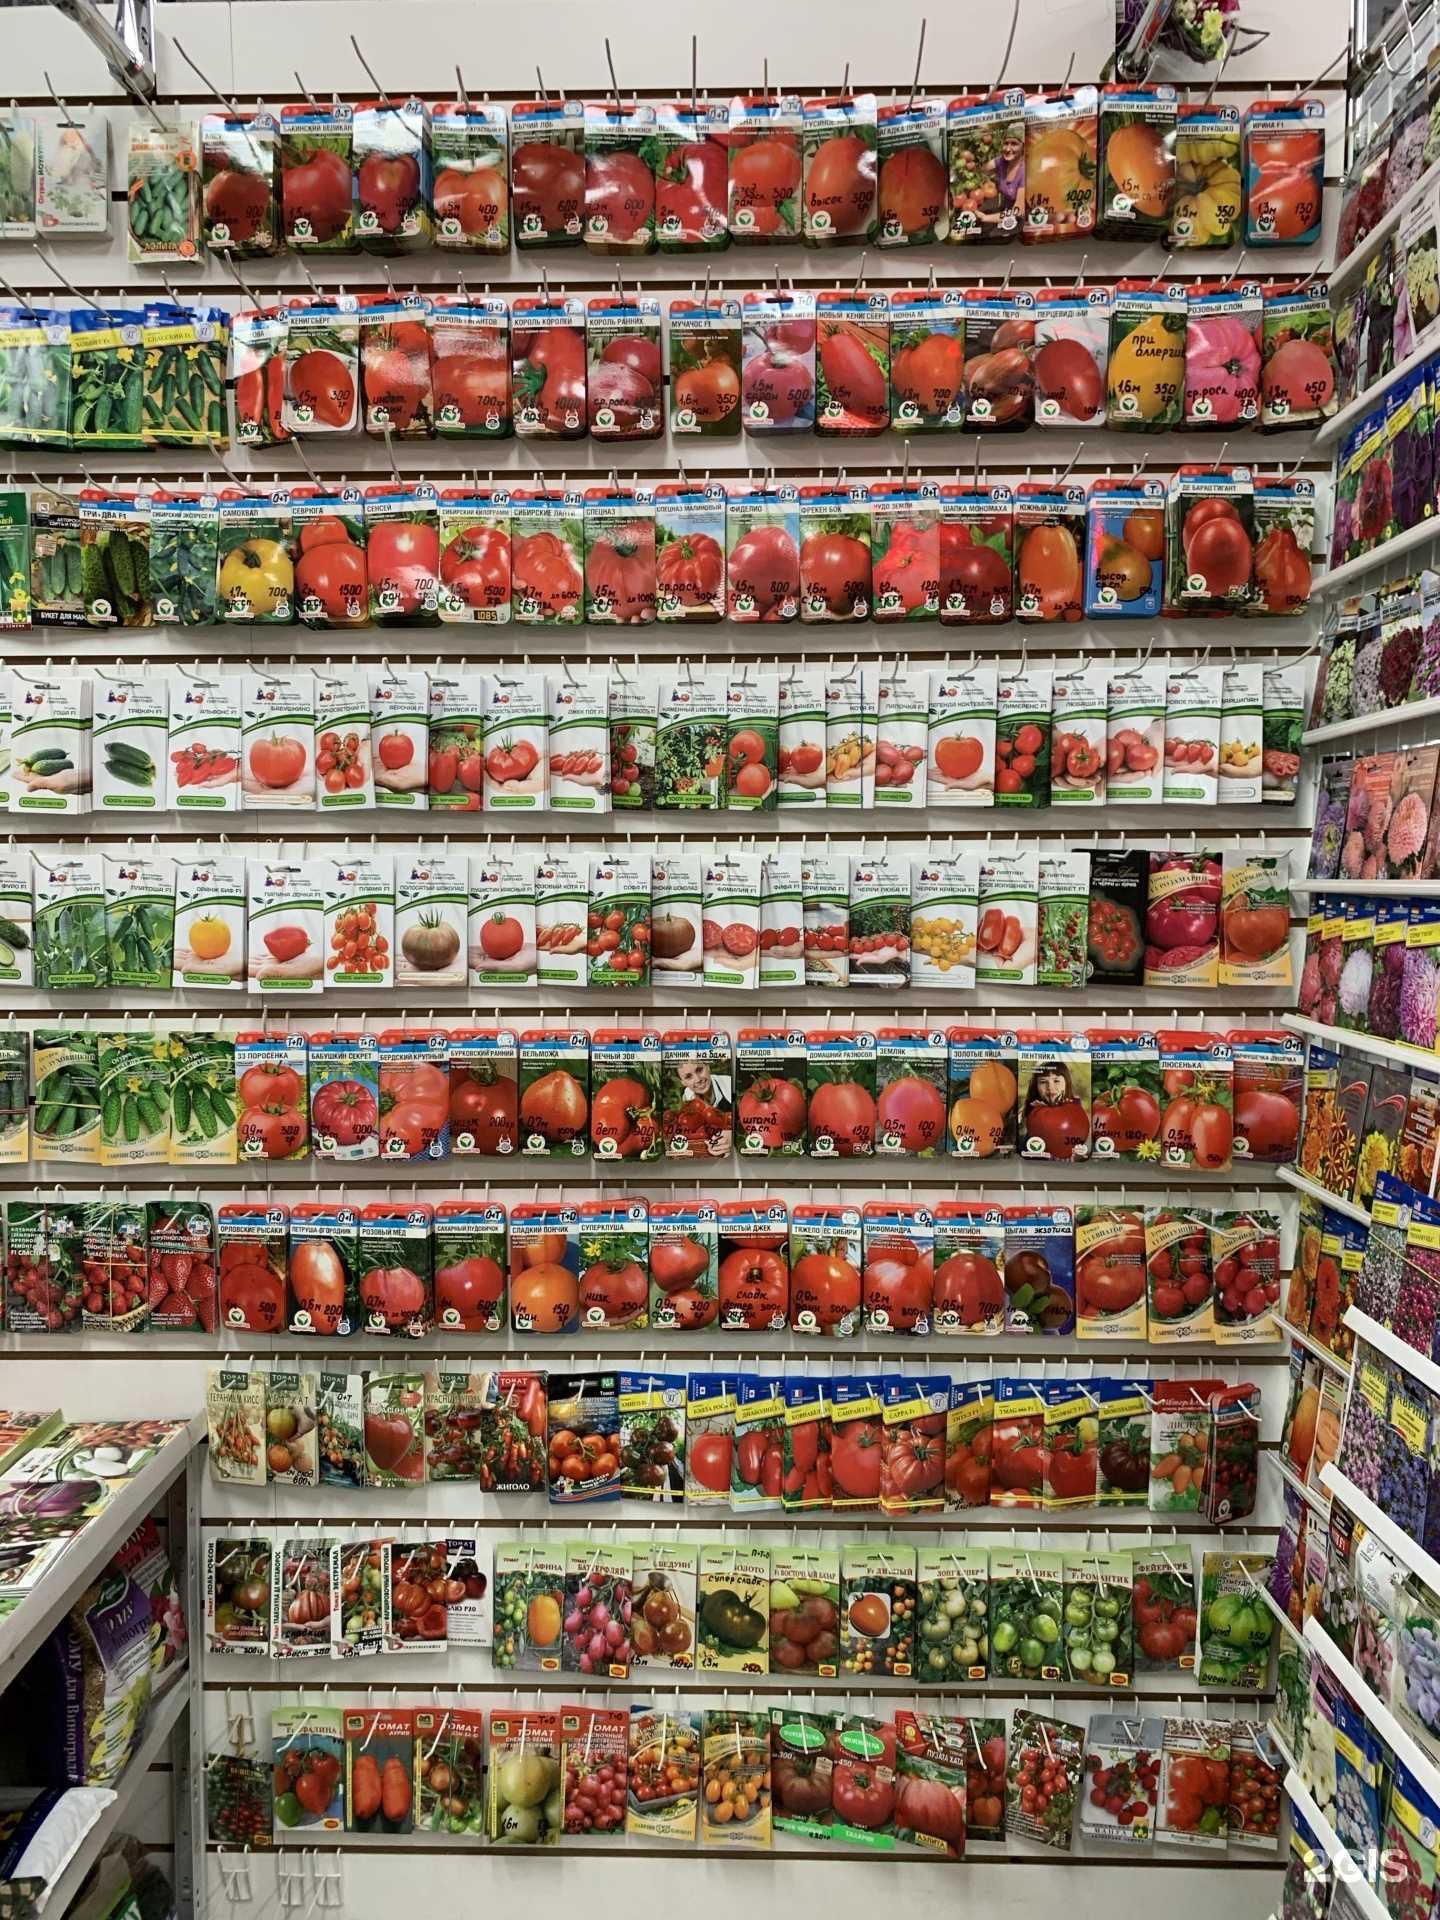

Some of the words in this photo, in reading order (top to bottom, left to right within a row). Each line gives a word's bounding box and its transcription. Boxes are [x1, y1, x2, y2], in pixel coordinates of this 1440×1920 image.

[1216, 206, 1234, 217] 350
[1133, 335, 1155, 346] при
[1154, 384, 1176, 395] 350
[1305, 381, 1326, 393] 450
[1235, 388, 1254, 399] 400
[293, 507, 324, 515] СЕВРЮГА
[367, 504, 392, 512] СЕНСЕЙ
[269, 587, 287, 597] 700
[60, 612, 71, 620] ДЛЯ
[247, 1052, 288, 1060] ПОРОСЕНКА
[312, 1052, 347, 1060] БАБУШКИН
[740, 1049, 771, 1057] ДЕМИДОВ
[880, 1048, 906, 1056] ЗЕМЛЯК
[985, 1050, 1001, 1058] ЯЙЦА
[257, 1226, 283, 1234] РЫСАКИ
[291, 1227, 316, 1235] ПЕТРУША
[318, 1227, 351, 1235] ОГОРОДНИК
[362, 1228, 391, 1237] РОЗОВЫЙ
[512, 1226, 542, 1234] СЛАДКИЙ
[867, 1226, 911, 1234] ЦИФОМАНДРА
[496, 1483, 530, 1491] ЖИГОЛО
[332, 1550, 340, 1590] ЭКСТРЕМАЛ
[1079, 1572, 1129, 1583] РОМАНТИК
[518, 1729, 555, 1737] ТОМАТ
[948, 1754, 964, 1766] ХАТА
